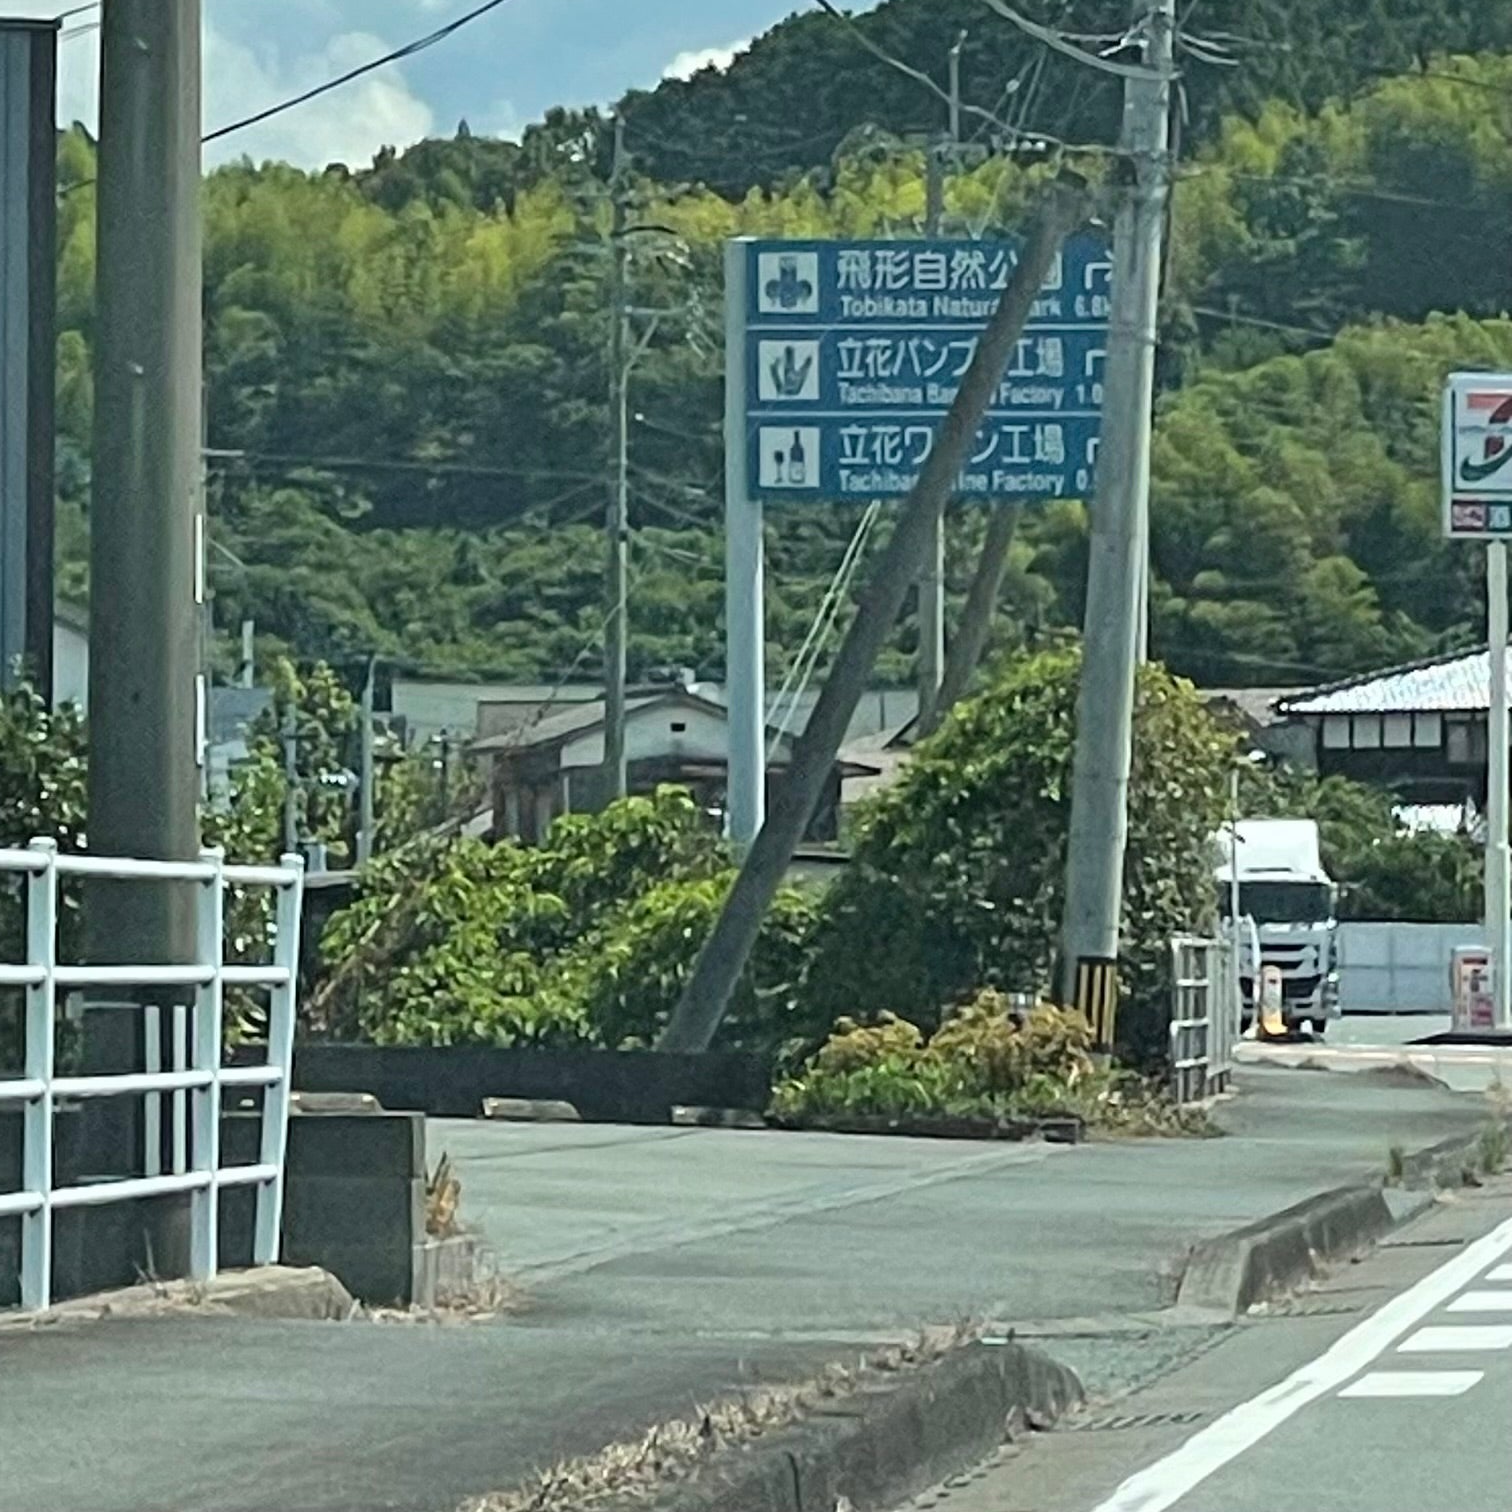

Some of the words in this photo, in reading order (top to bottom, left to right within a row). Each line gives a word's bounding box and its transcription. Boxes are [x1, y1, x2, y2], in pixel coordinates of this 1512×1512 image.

[836, 249, 1063, 290] 飛形自然公
[840, 295, 928, 318] Tobikata
[933, 296, 1001, 318] Natura
[1027, 297, 1062, 318] ark
[836, 337, 1064, 378] 立花バンブ工場
[999, 382, 1064, 410] Factory
[838, 424, 1065, 465] 立花ワン工場
[838, 469, 920, 492] Tachiba
[951, 470, 988, 491] ine
[991, 470, 1065, 497] Factory
